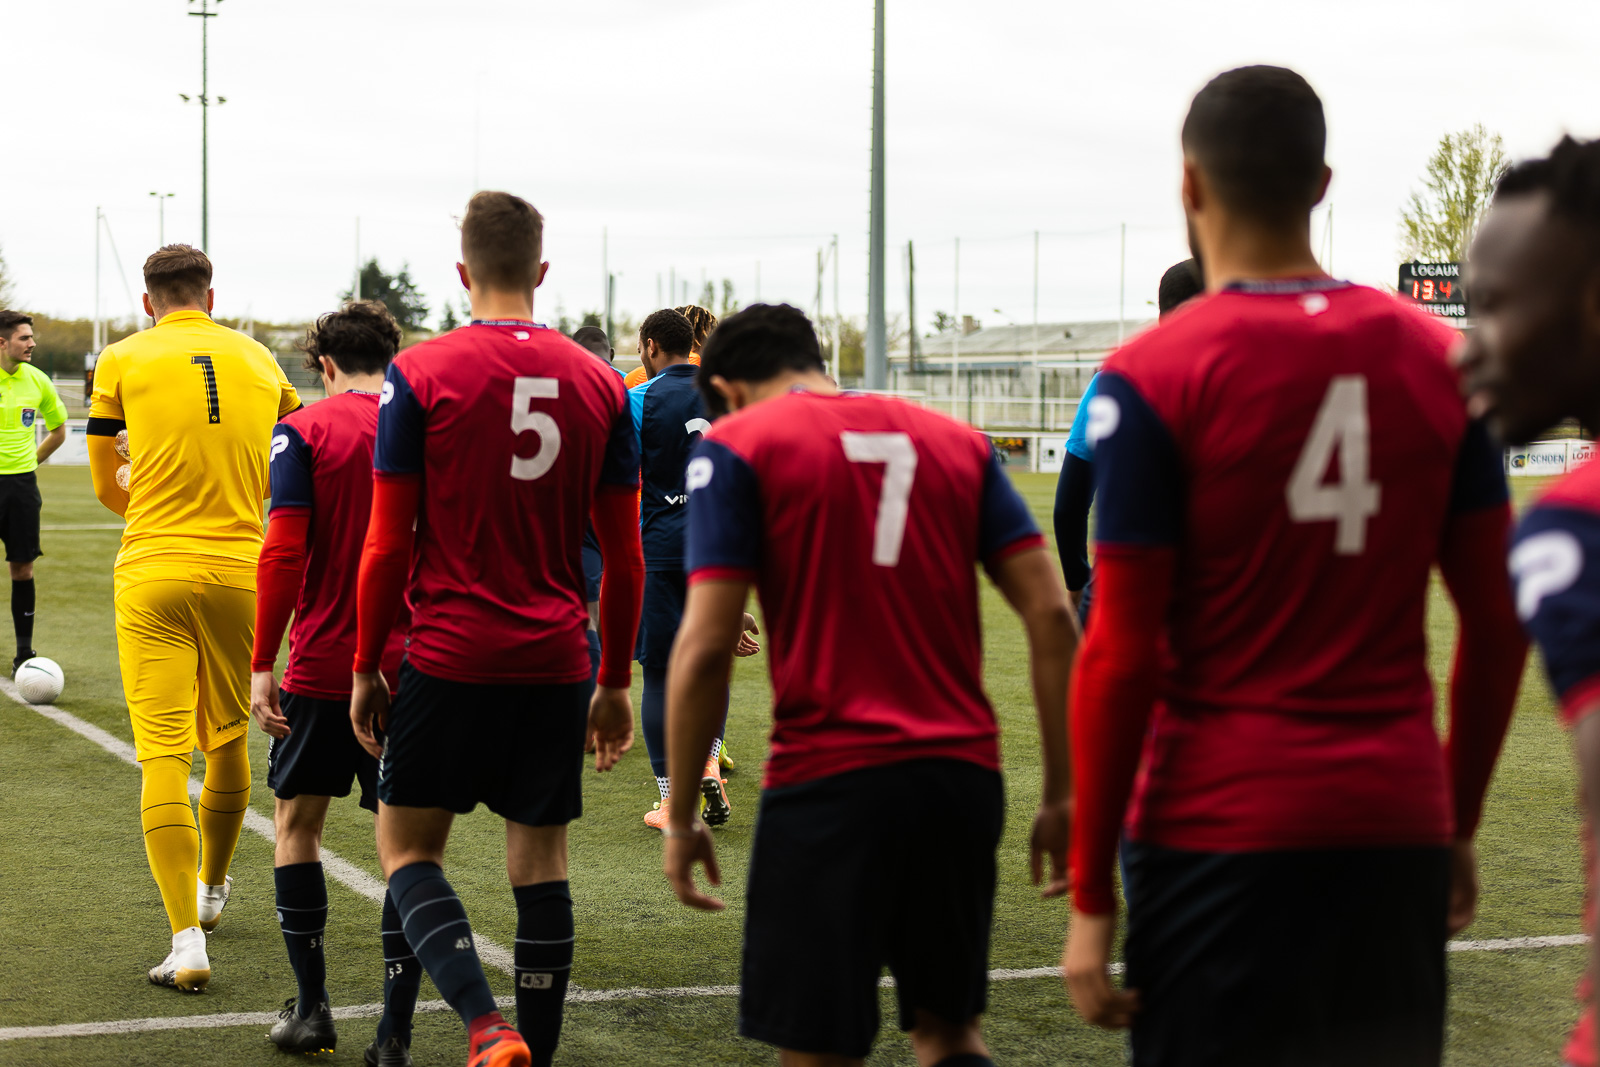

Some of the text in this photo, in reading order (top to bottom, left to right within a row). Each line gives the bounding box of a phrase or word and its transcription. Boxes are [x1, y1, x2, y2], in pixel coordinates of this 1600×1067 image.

[1411, 265, 1459, 277] LOCAUX
[1408, 303, 1466, 316] SITEURS
[191, 355, 221, 424] 1
[510, 376, 561, 481] 5
[840, 431, 918, 567] 7
[1286, 373, 1382, 556] 4
[388, 963, 403, 980] 53
